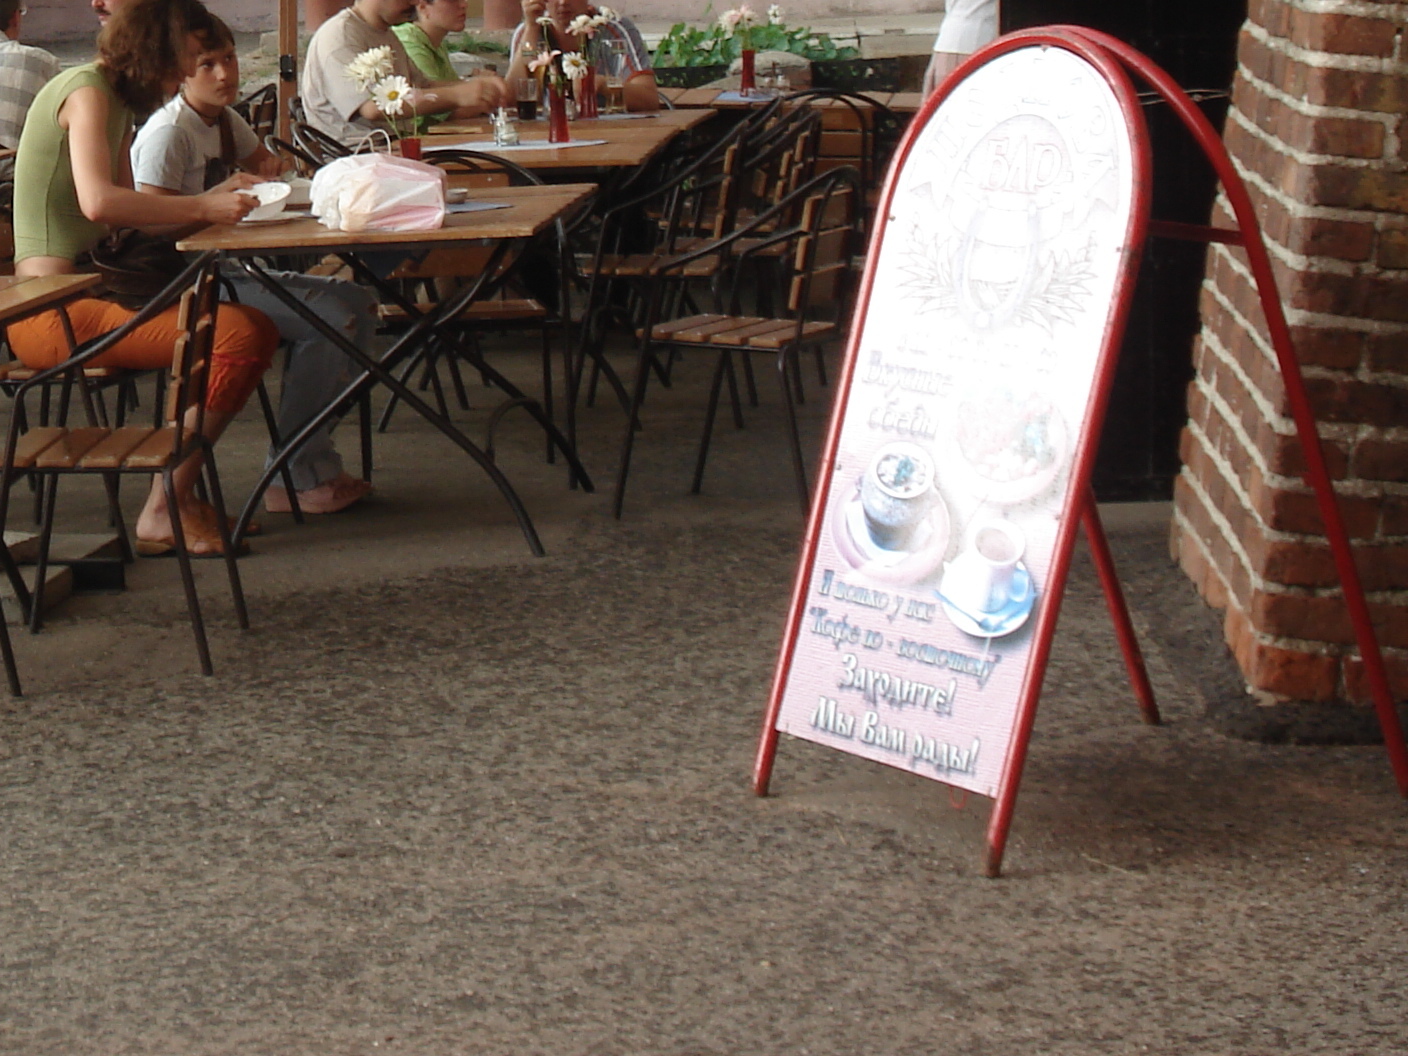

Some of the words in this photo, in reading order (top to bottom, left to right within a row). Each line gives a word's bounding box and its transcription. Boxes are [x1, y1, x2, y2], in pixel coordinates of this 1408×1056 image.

[979, 134, 1063, 194] БАР
[838, 652, 958, 717] Заходите!
[810, 694, 857, 740] Мы
[910, 736, 981, 777] рады!
